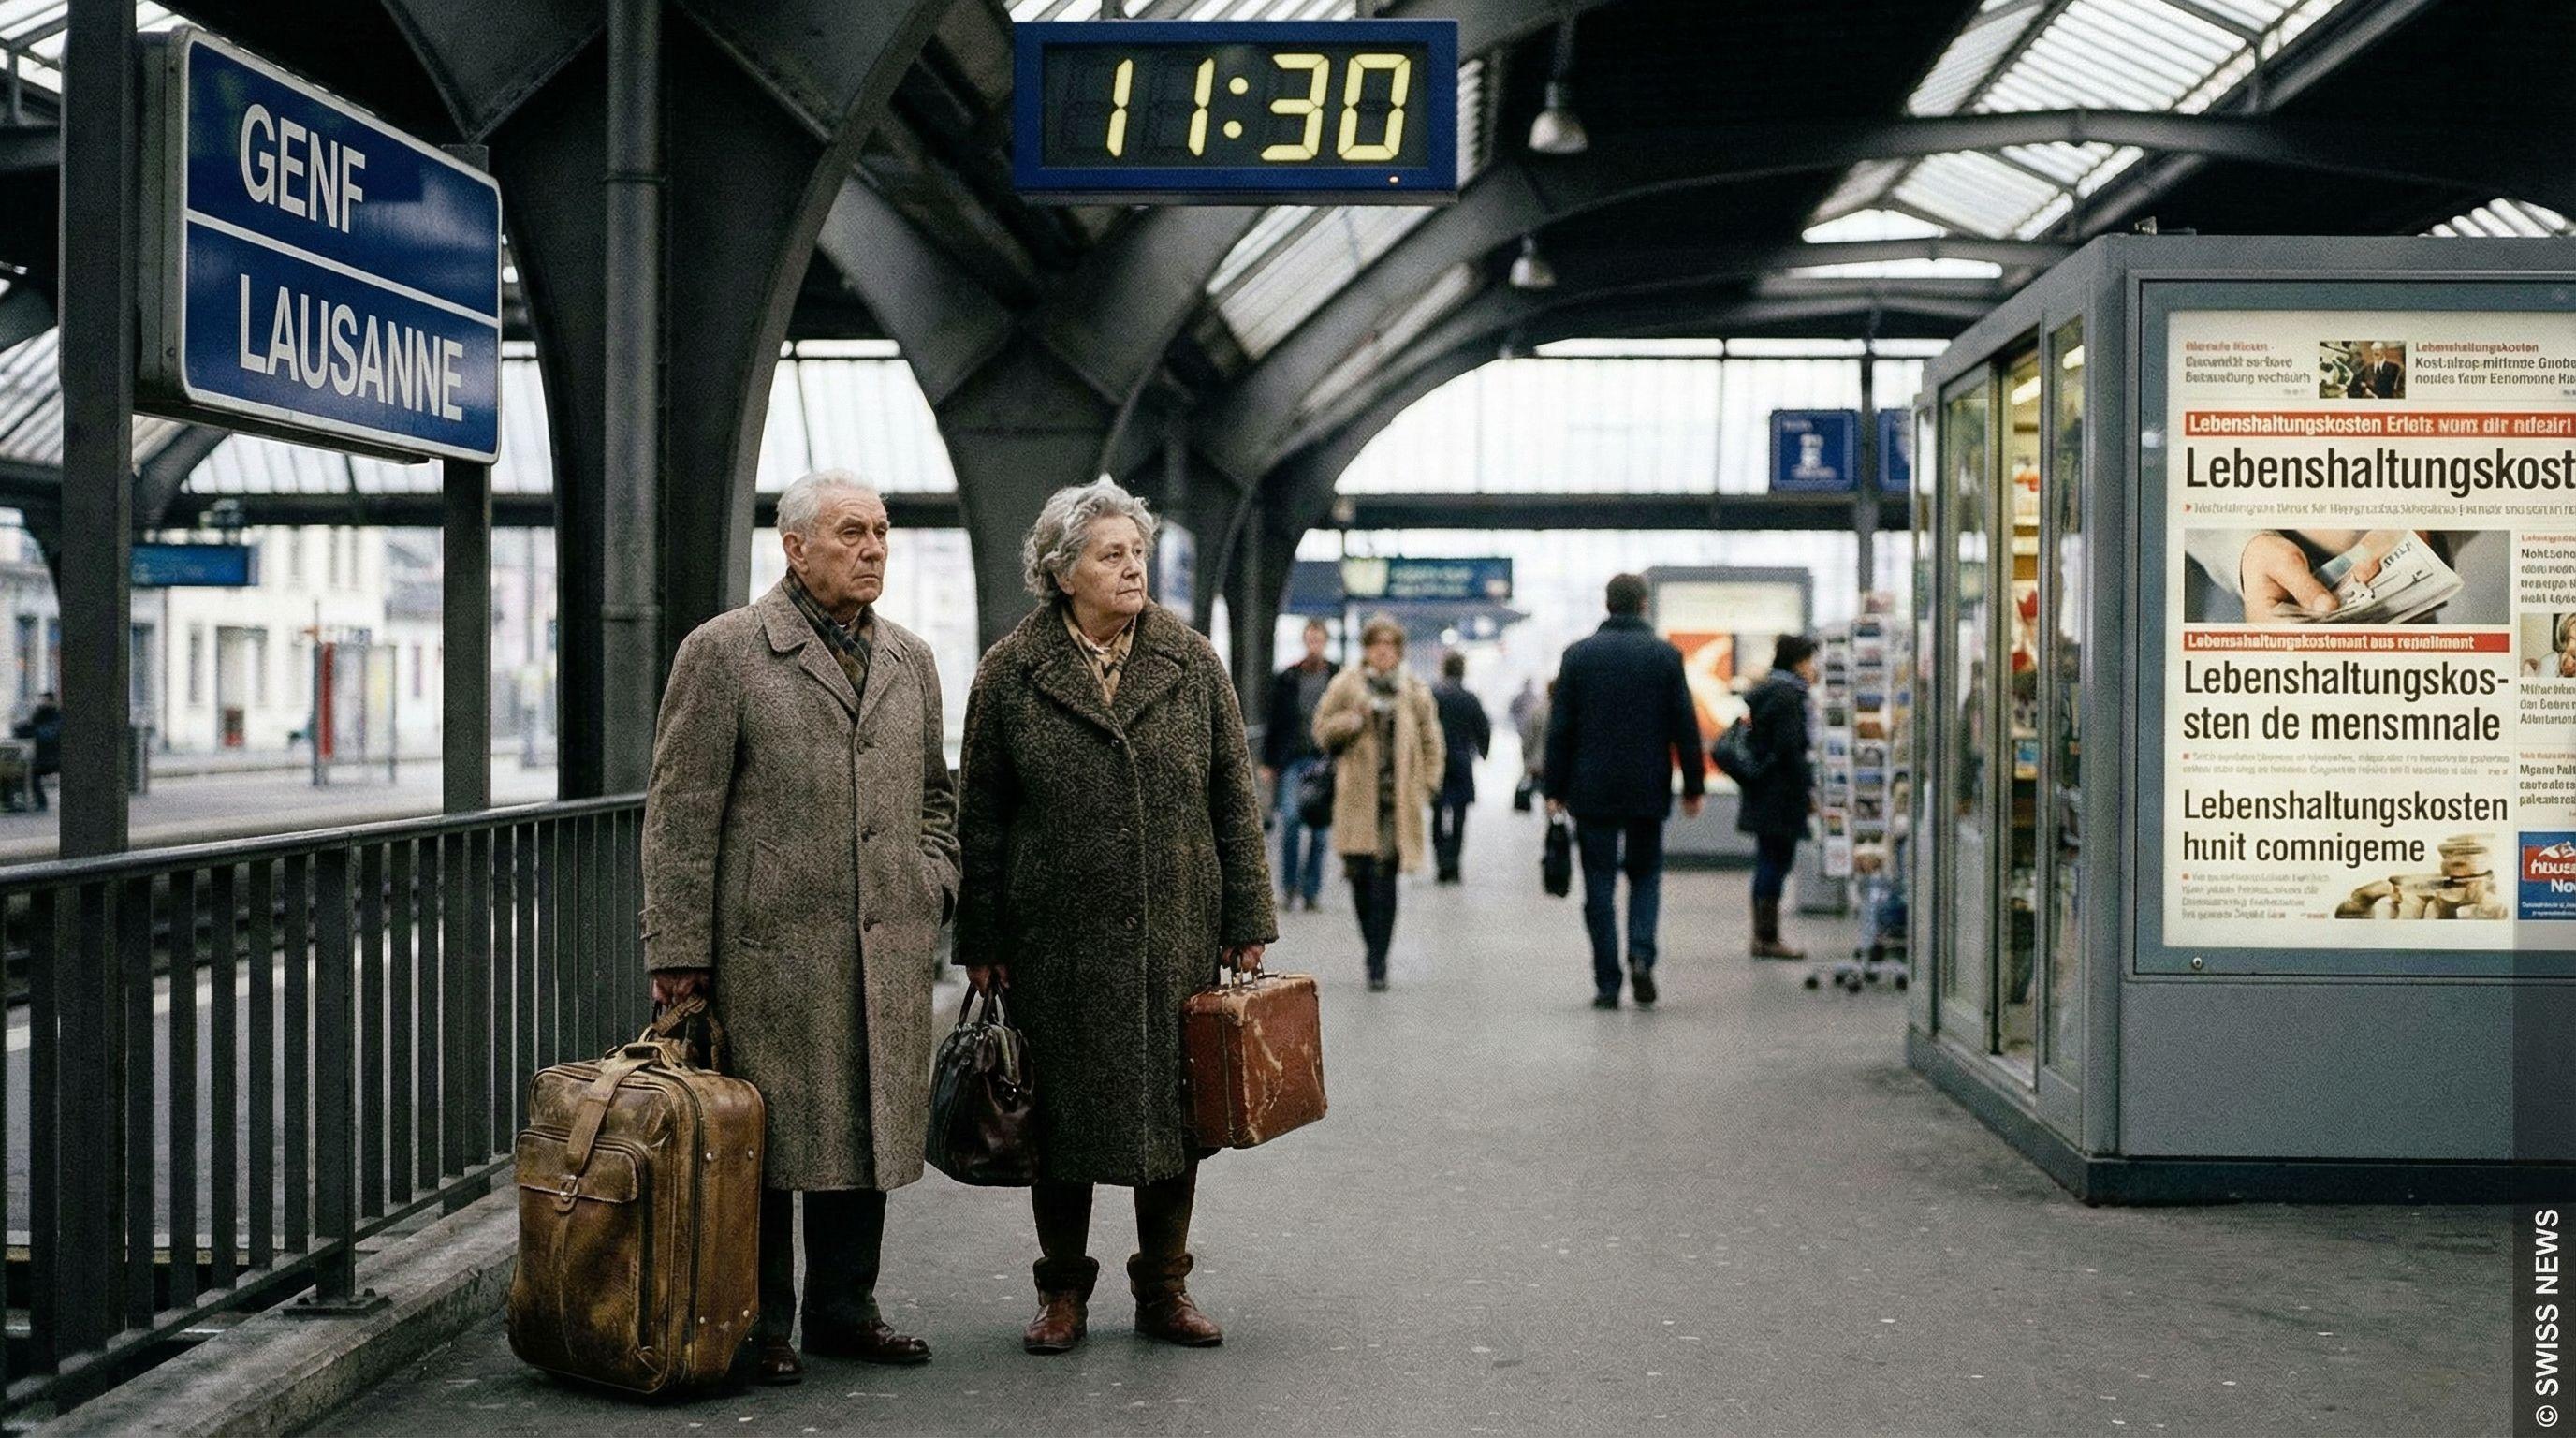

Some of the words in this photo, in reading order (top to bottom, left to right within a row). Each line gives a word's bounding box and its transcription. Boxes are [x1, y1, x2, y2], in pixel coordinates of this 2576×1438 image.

[1106, 53, 1411, 160] 11:30
[241, 103, 365, 233] GENF
[240, 273, 463, 421] LAUSANNE
[2189, 415, 2382, 435] Lebenshaltungskosten
[2187, 447, 2576, 498] Lebenshaltungskost
[2185, 660, 2509, 703] Lebenshaltungskos-
[2183, 707, 2250, 740] sten
[2262, 705, 2300, 740] de
[2311, 707, 2501, 741] mensmnale
[2185, 789, 2509, 828] Lebenshaltungskosten
[2256, 832, 2425, 869] comnigeme
